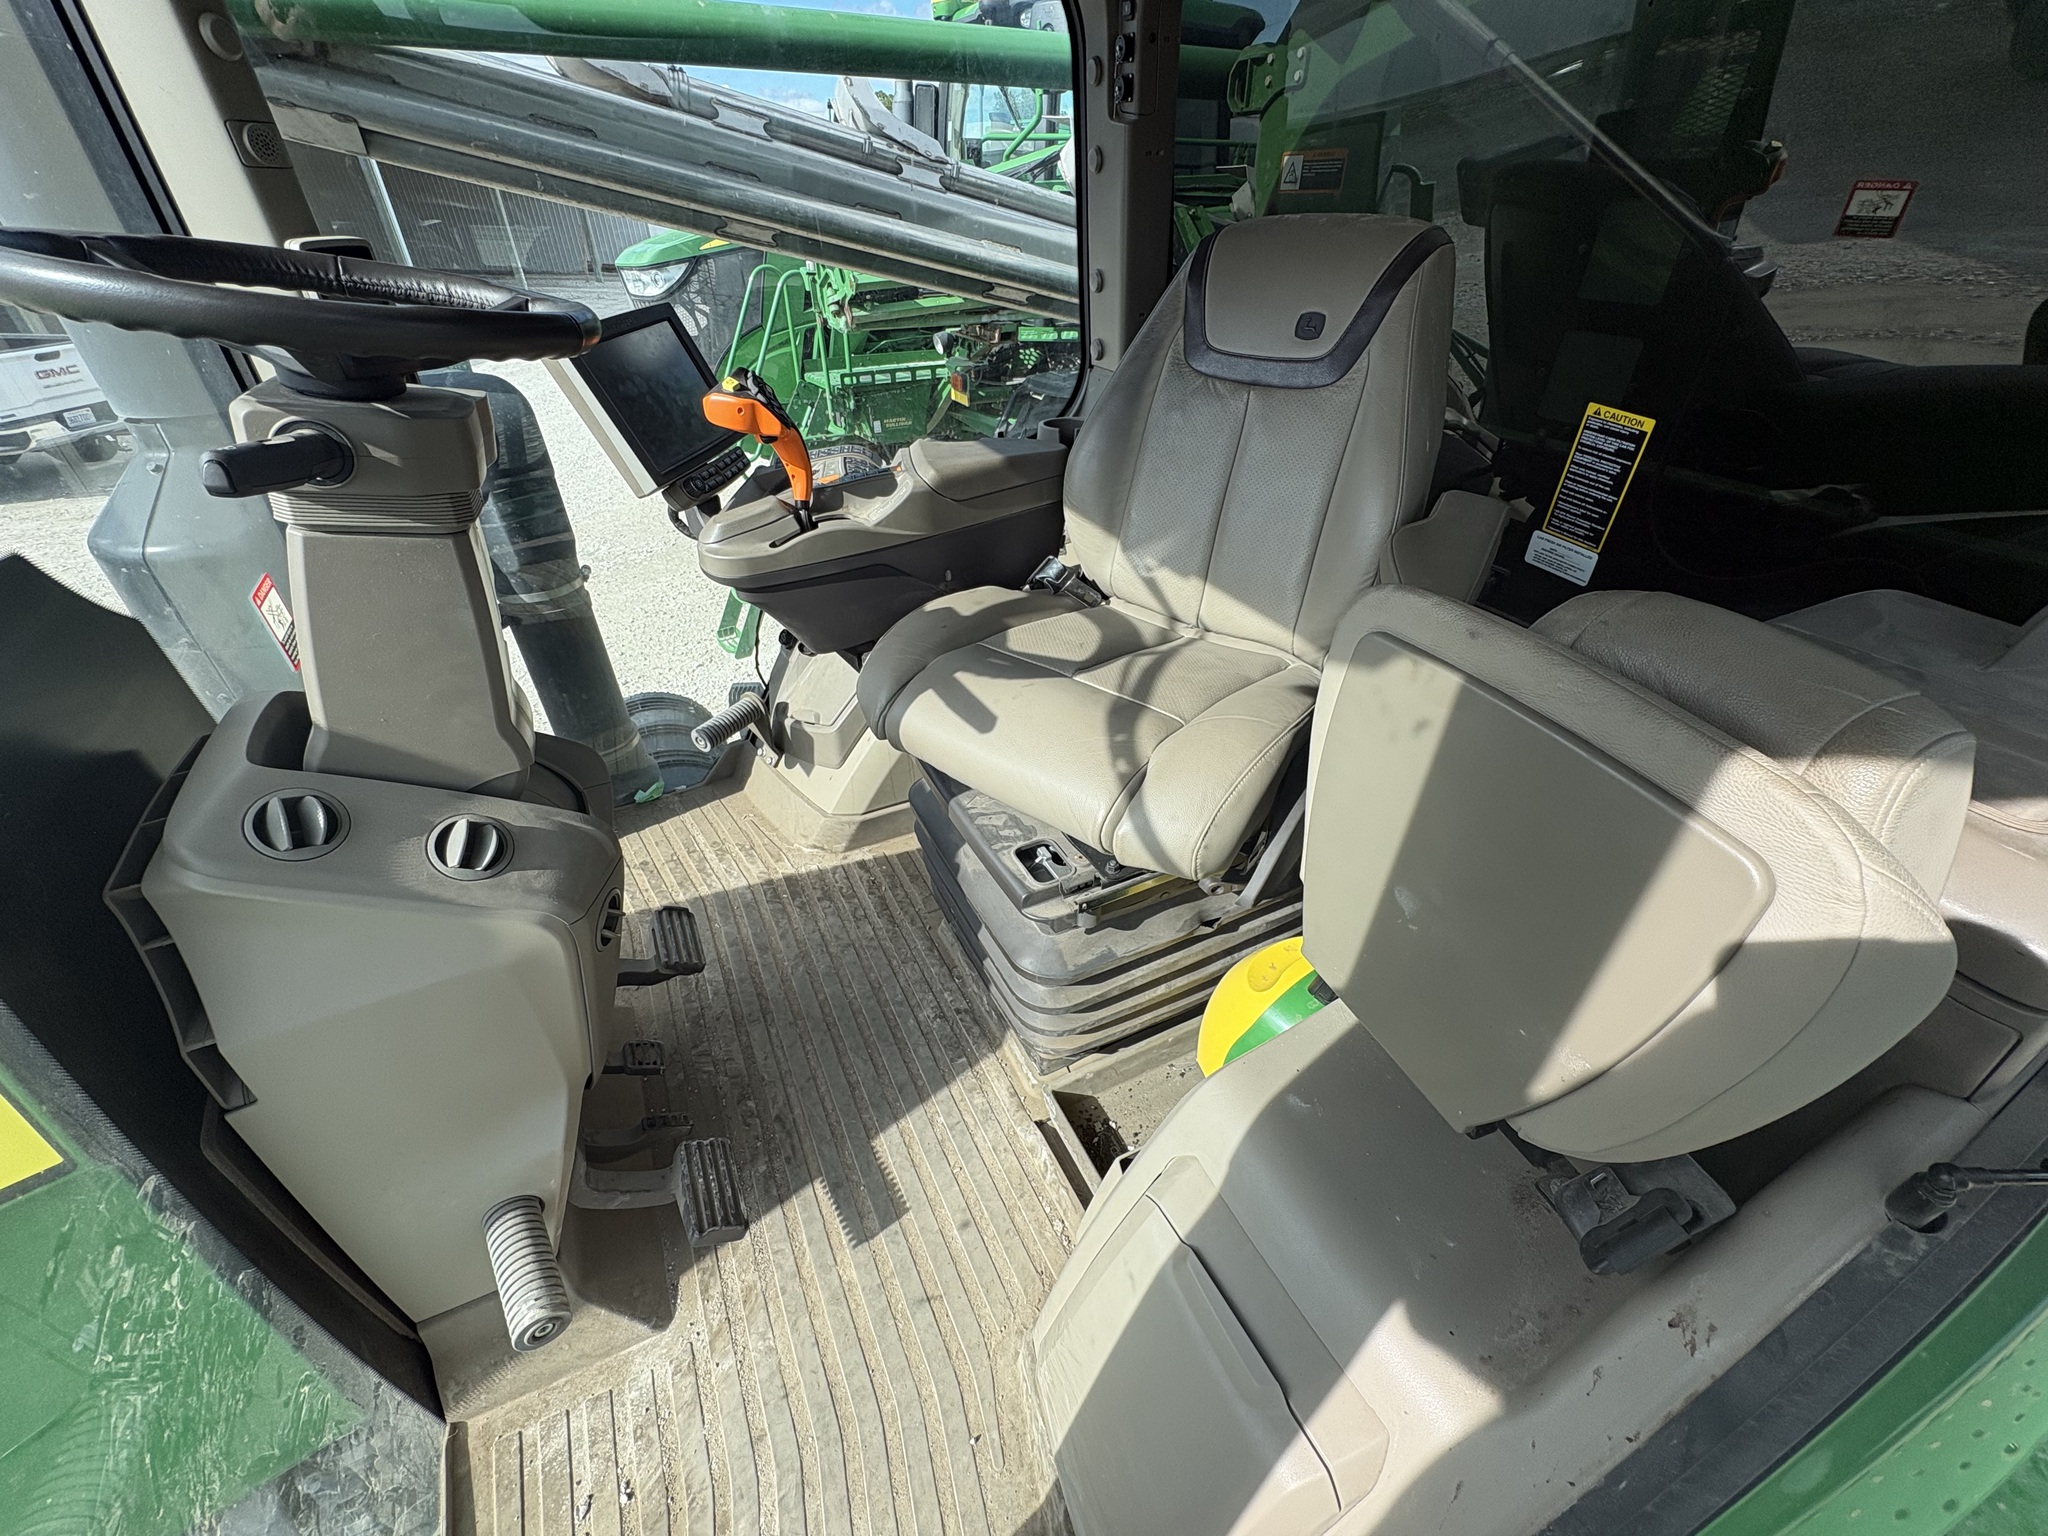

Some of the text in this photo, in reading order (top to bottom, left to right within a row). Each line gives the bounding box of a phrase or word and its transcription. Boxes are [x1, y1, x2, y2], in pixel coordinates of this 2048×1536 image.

[35, 364, 81, 380] GMC
[1603, 410, 1645, 429] CAUTION
[258, 578, 273, 601] DANGER
